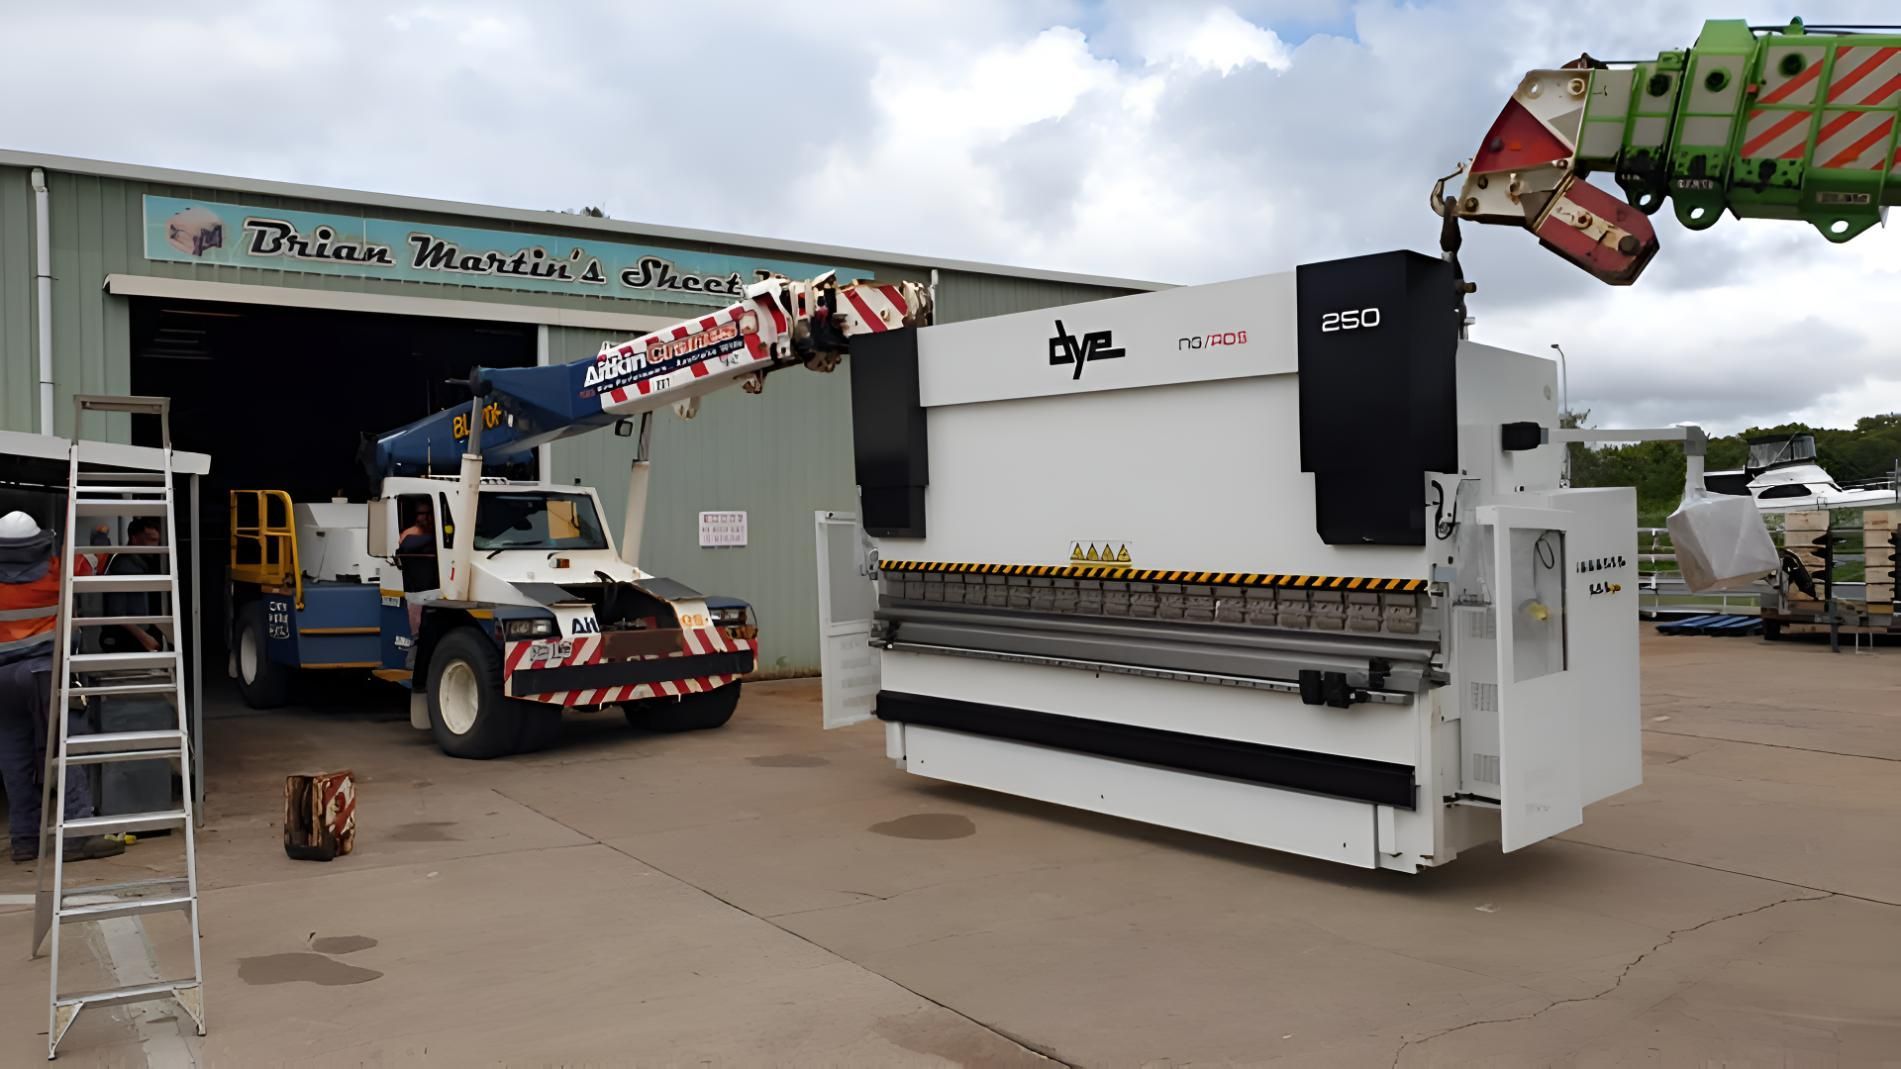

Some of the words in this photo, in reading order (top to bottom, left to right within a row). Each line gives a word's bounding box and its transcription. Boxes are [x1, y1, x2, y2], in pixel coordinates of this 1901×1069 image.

[245, 218, 394, 265] Brian
[409, 234, 606, 283] Martin's
[620, 257, 743, 296] Sheet
[1322, 307, 1380, 332] 250
[584, 351, 647, 387] Aitkin
[1049, 320, 1126, 380] dye
